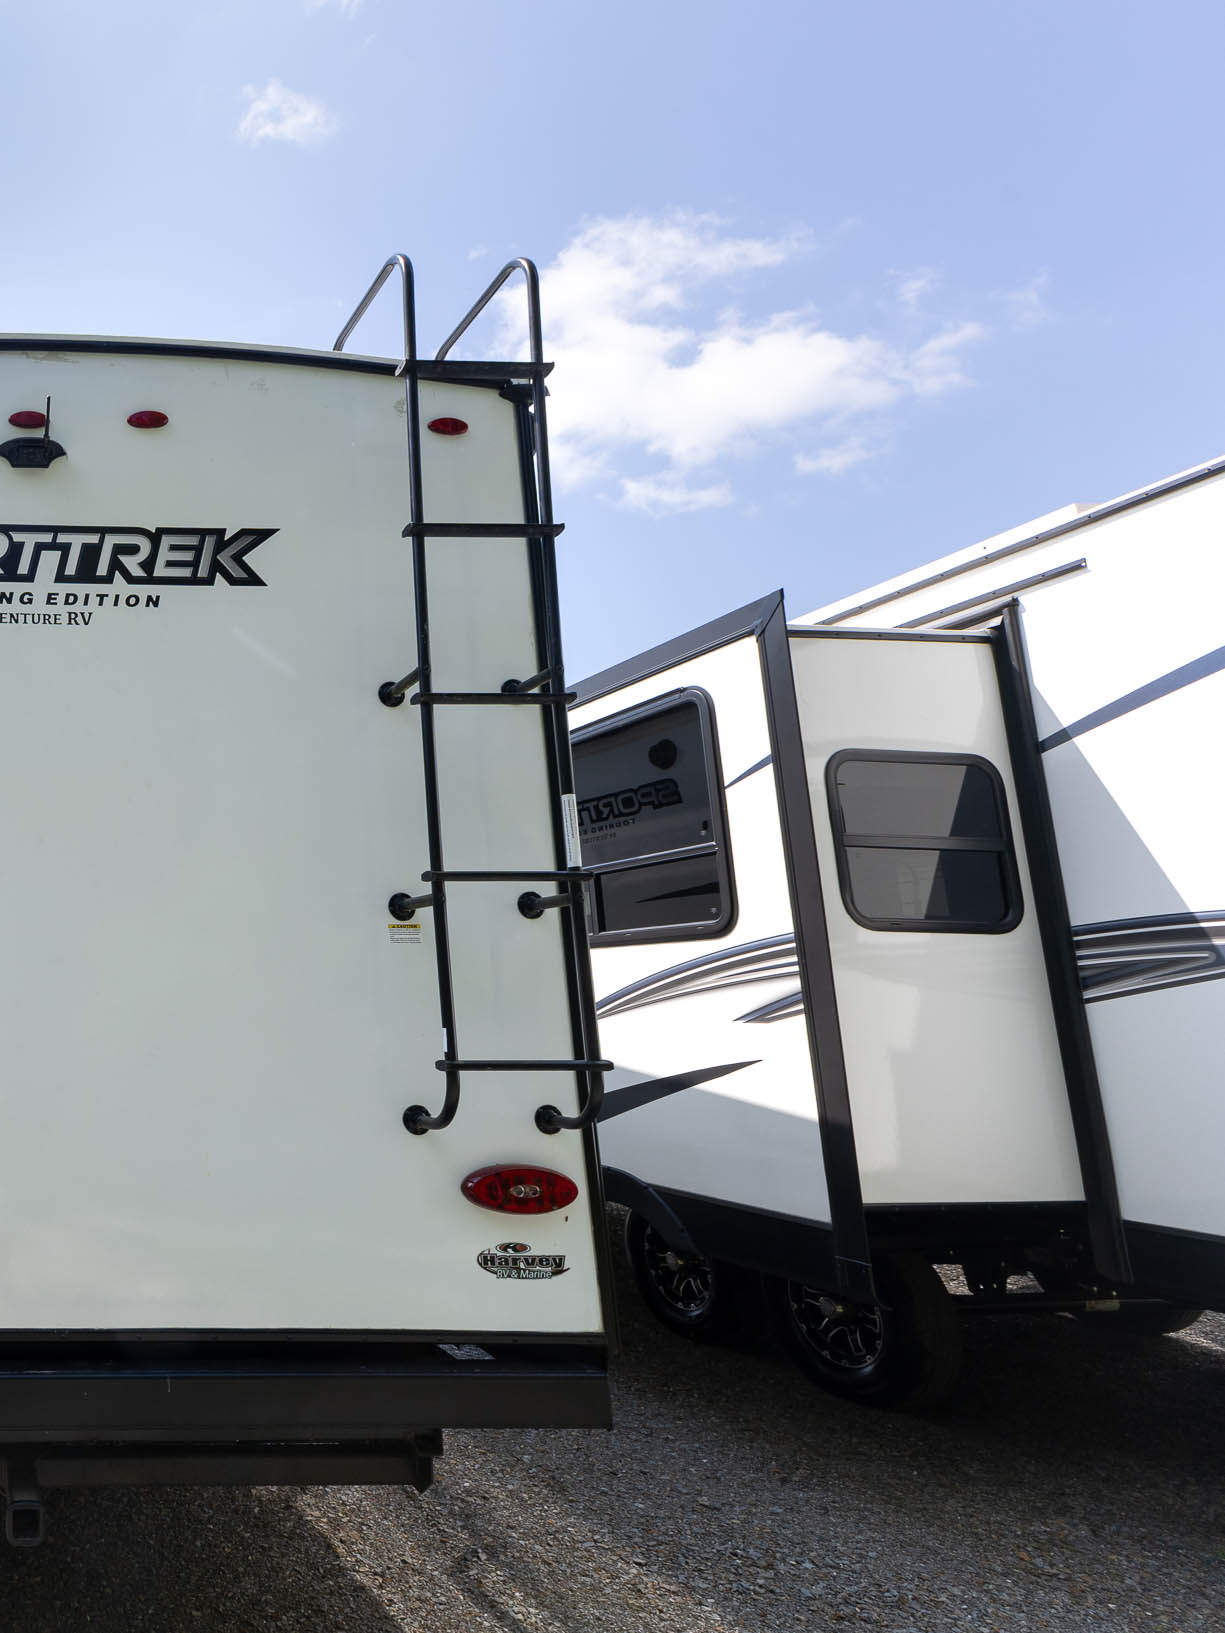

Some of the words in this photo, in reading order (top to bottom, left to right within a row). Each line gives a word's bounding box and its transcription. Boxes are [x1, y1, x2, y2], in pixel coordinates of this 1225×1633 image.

[45, 592, 161, 608] EDITION
[66, 611, 93, 626] RV
[480, 1254, 566, 1270] Harvey
[497, 1269, 509, 1278] RV
[511, 1269, 519, 1278] &
[520, 1269, 552, 1278] Marine
